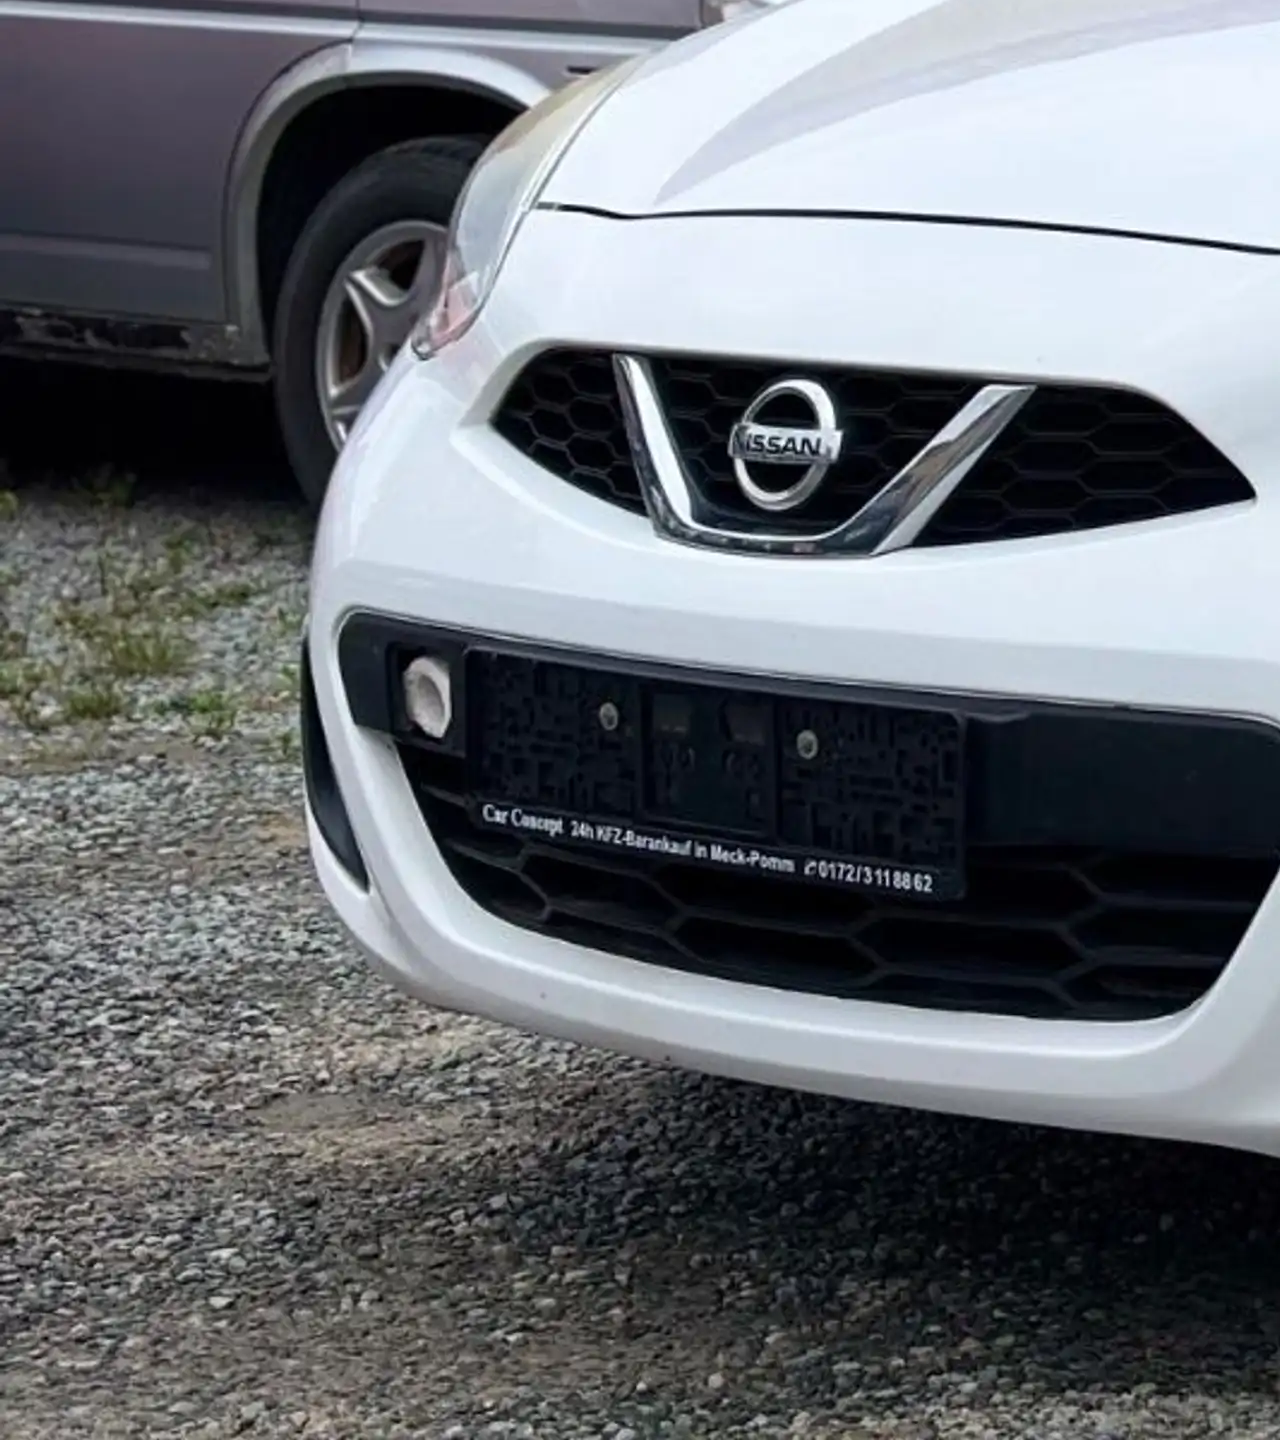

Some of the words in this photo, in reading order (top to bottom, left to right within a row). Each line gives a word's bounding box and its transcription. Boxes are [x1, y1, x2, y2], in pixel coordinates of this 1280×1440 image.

[734, 430, 822, 457] NISSAN
[482, 803, 508, 825] Car
[510, 809, 564, 837] Concept
[570, 820, 594, 840] 24h
[597, 825, 692, 856] KFZ-Barankauf
[694, 843, 708, 859] in
[710, 844, 795, 873] Meck-Pomm
